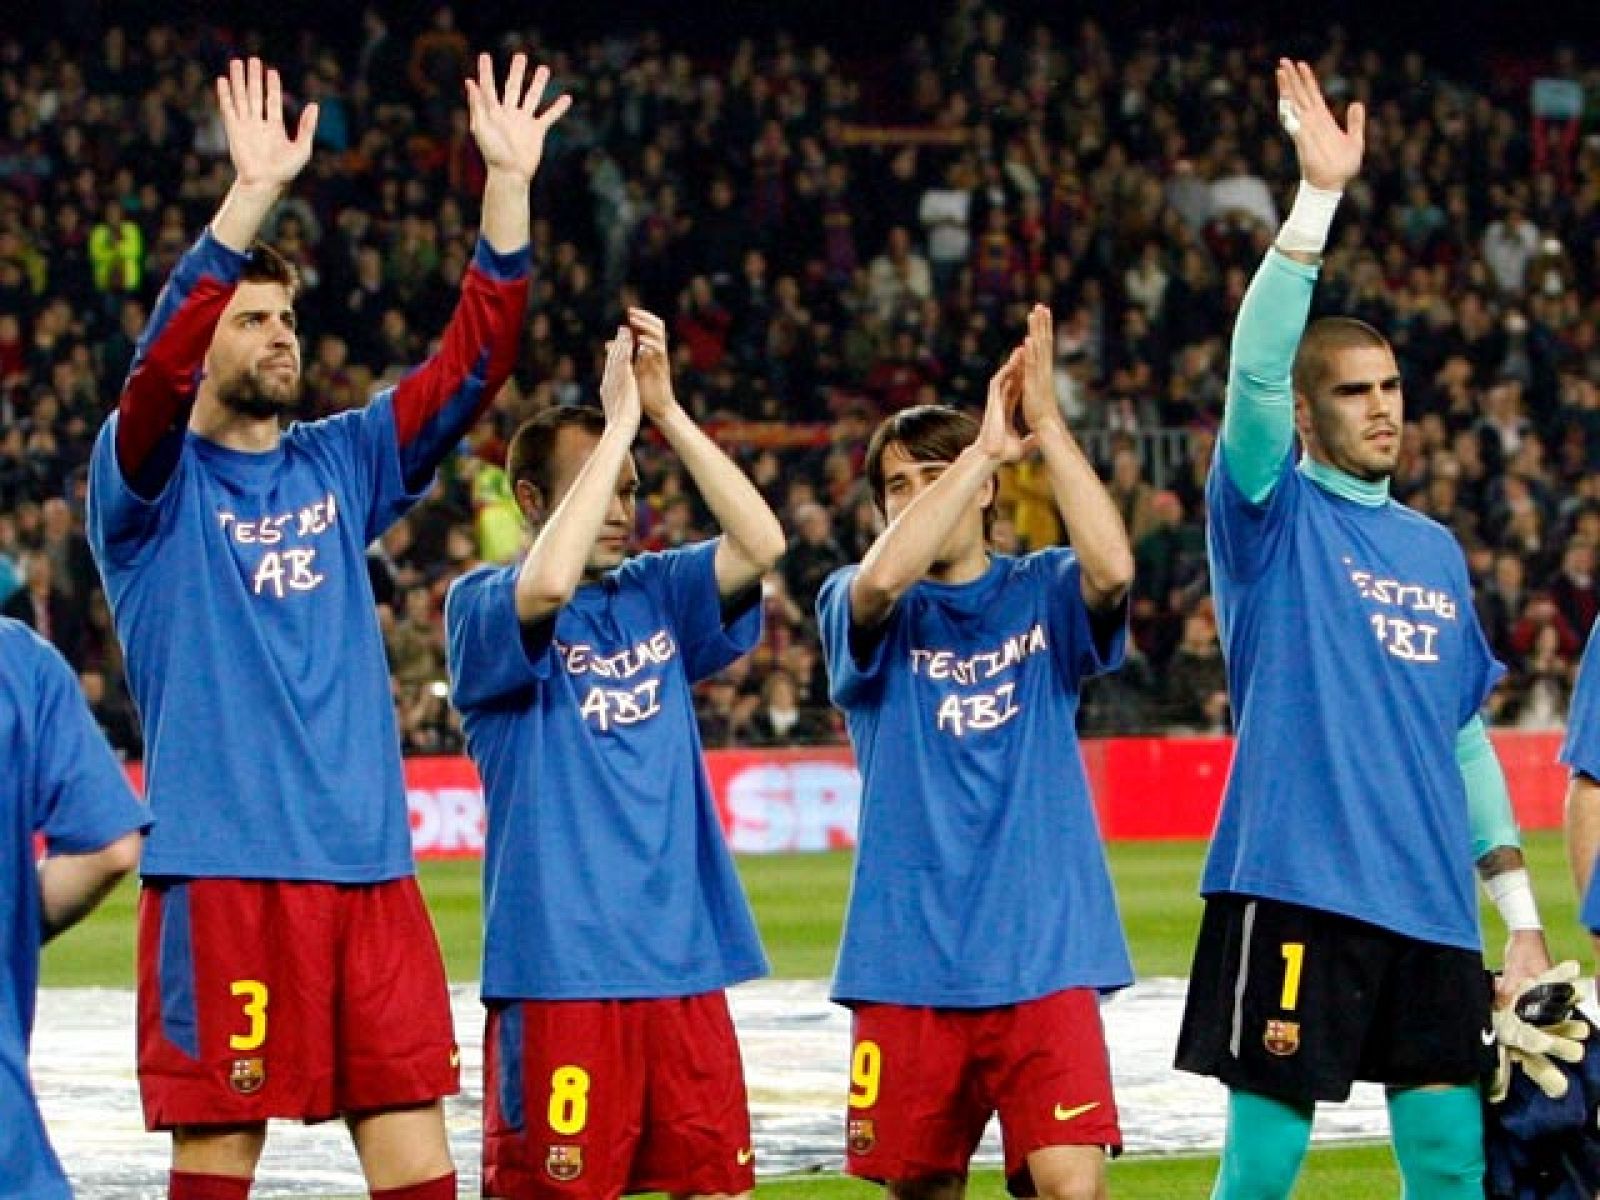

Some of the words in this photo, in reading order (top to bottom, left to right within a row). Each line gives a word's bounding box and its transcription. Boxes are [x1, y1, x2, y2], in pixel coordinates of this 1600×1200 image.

[253, 547, 325, 599] AB
[580, 679, 661, 731] ABI
[935, 682, 1021, 736] ABI
[406, 787, 485, 850] OR
[1280, 942, 1305, 1011] 1
[229, 979, 269, 1051] 3
[547, 1064, 590, 1136] 8
